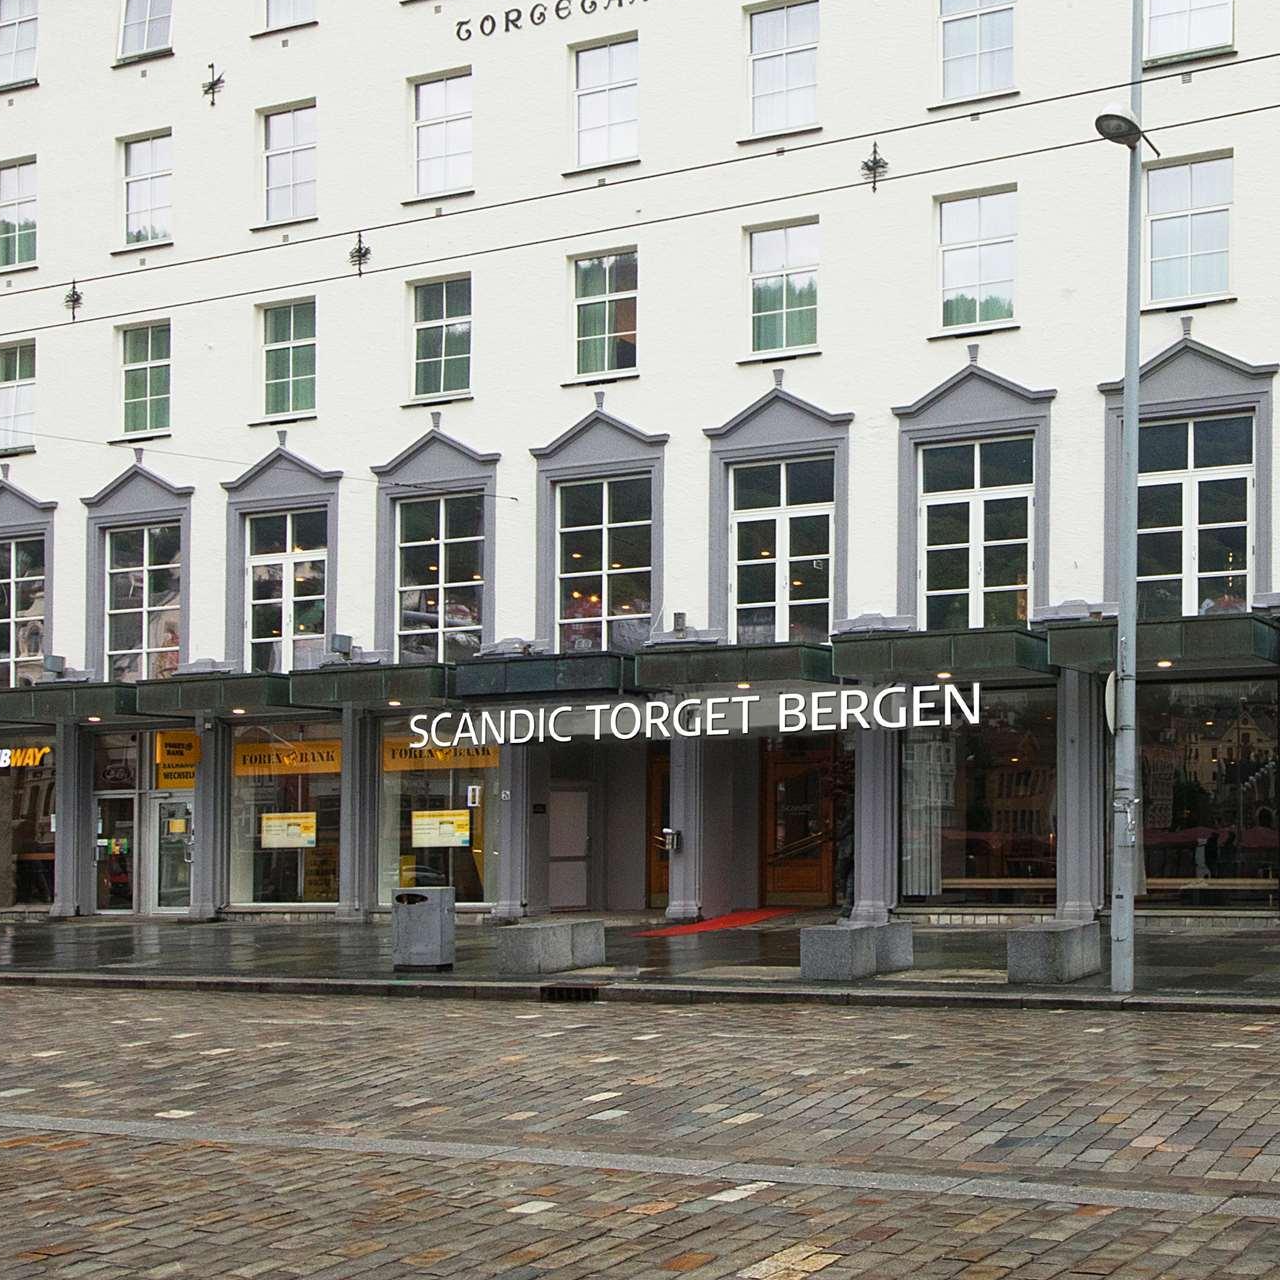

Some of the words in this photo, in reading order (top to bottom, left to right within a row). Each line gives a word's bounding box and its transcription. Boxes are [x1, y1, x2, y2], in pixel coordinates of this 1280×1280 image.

[409, 706, 572, 748] SCANDIC
[586, 695, 760, 740] TORGET
[778, 682, 980, 733] BERGEN
[242, 752, 282, 765] FOREX
[300, 750, 336, 763] BANK
